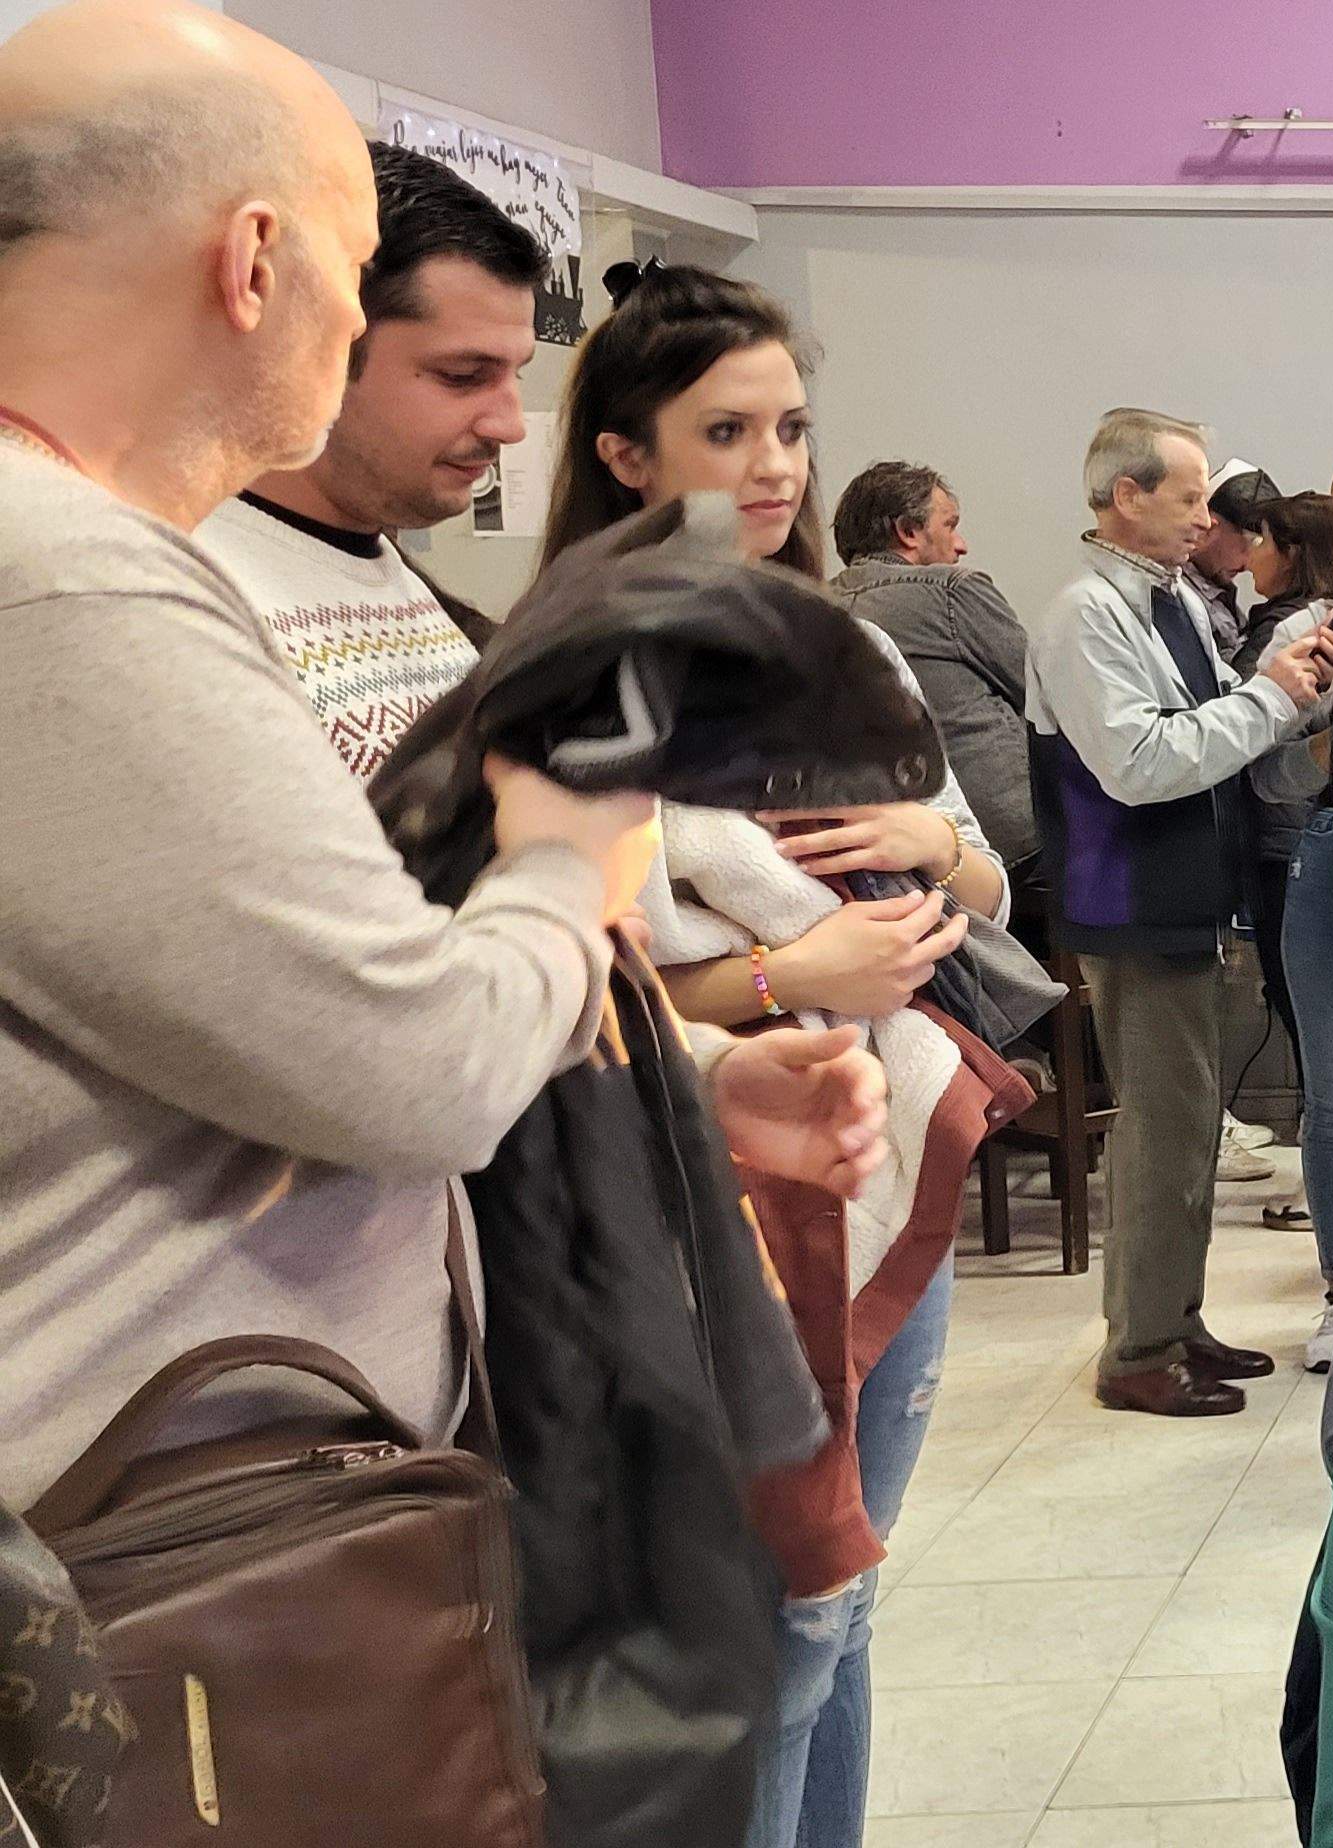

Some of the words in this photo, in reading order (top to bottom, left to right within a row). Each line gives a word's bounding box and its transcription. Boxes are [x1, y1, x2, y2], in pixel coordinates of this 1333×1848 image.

[500, 144, 520, 184] hay
[524, 160, 549, 192] mejor
[534, 200, 566, 245] equipo
